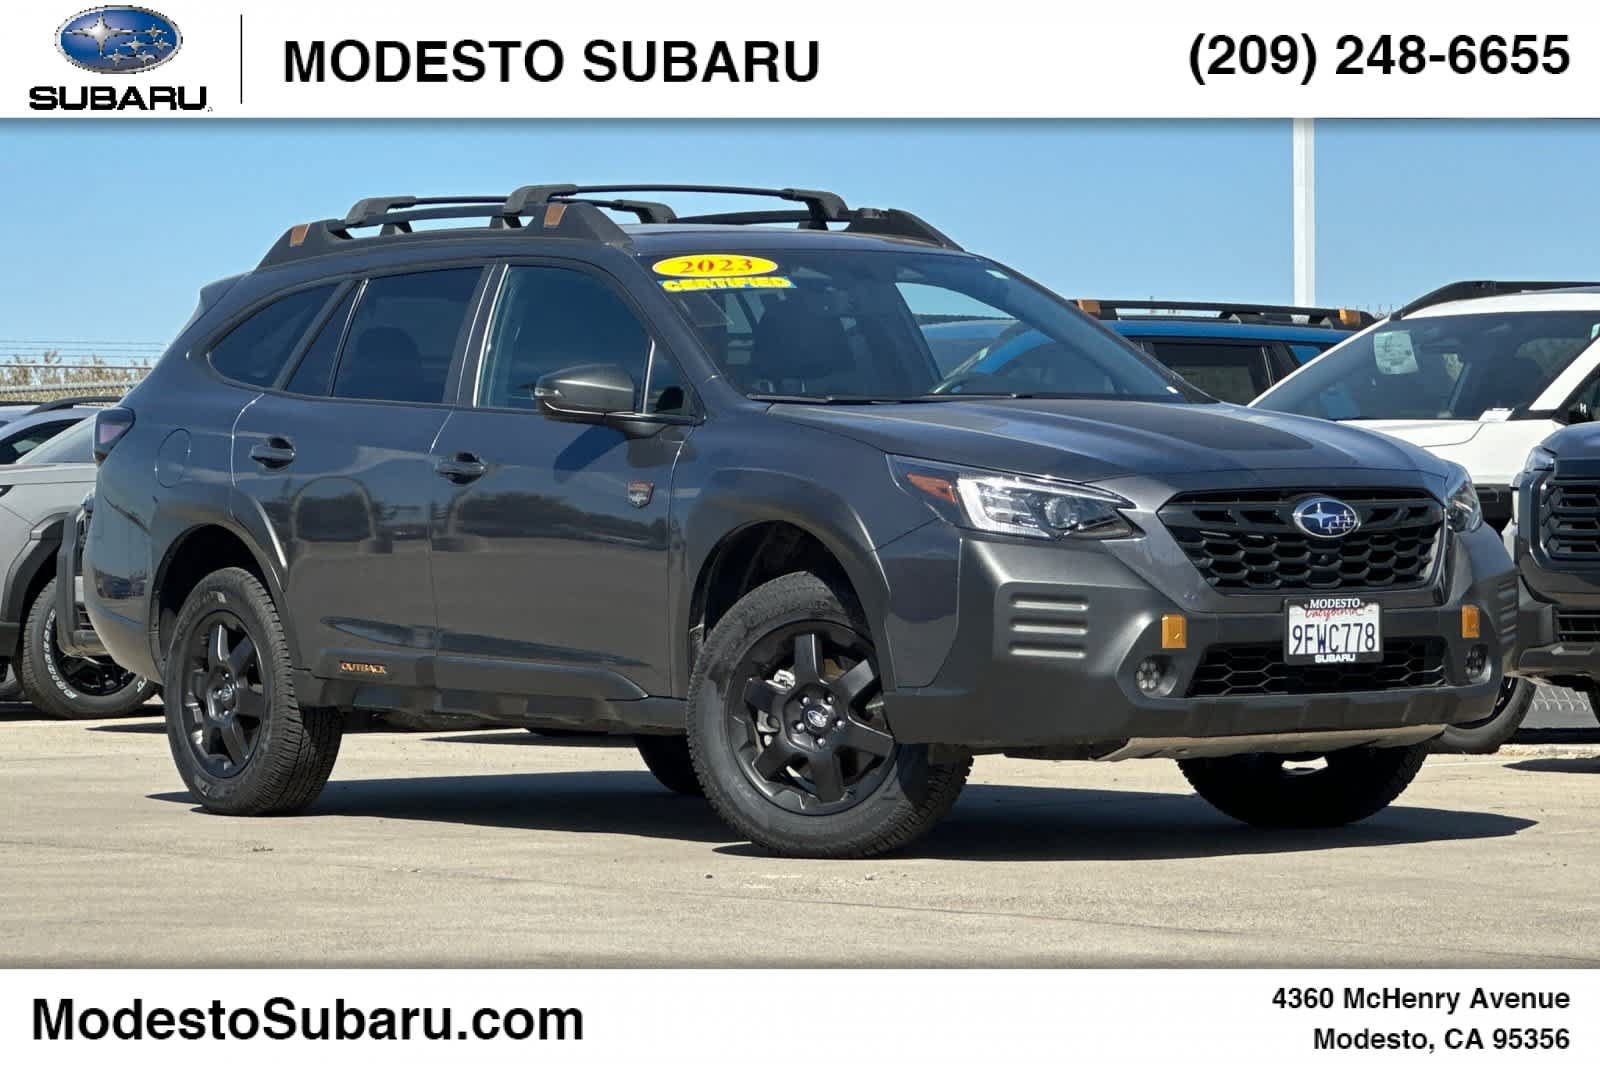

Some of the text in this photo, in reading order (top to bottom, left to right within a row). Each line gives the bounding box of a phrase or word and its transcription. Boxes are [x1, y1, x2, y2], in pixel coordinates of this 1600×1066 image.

[680, 259, 753, 273] 2023
[1309, 598, 1361, 609] MODESTO
[1292, 623, 1375, 654] 9FWC778
[1315, 653, 1356, 664] SUBARU
[340, 662, 386, 674] OUTBACK
